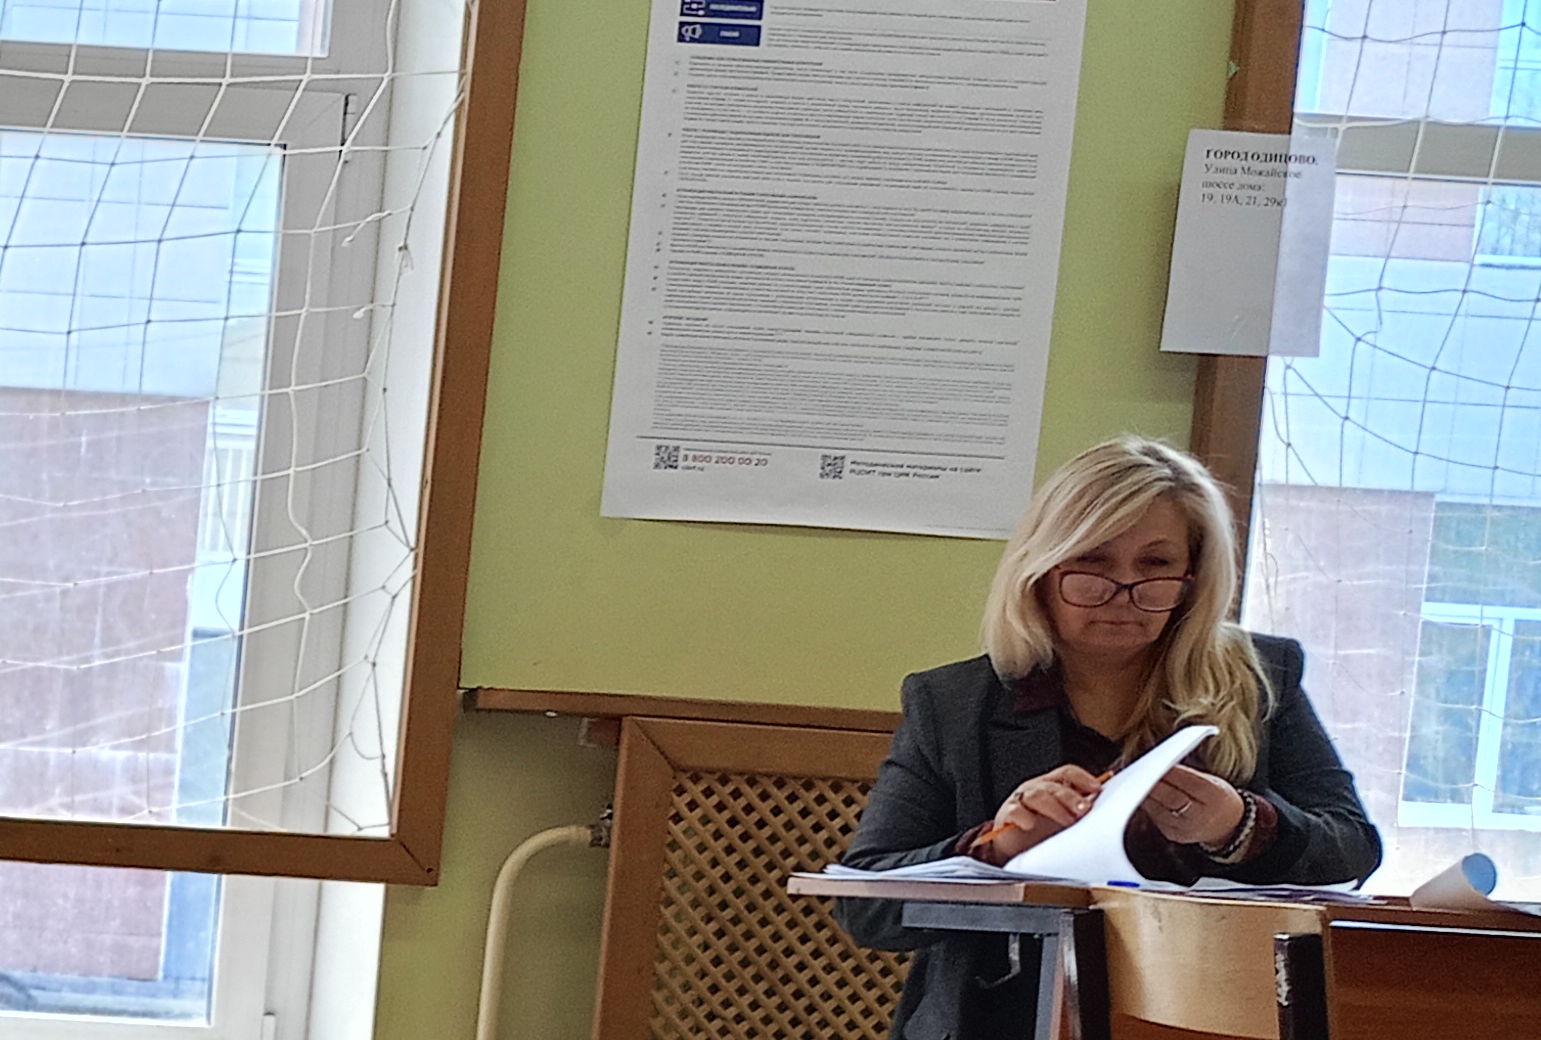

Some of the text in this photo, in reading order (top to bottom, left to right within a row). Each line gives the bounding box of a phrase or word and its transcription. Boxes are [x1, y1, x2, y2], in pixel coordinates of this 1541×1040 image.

[1205, 148, 1248, 162] ГОРОД
[1204, 163, 1302, 179] Улица Можайское
[1201, 180, 1235, 189] шоссе
[691, 454, 712, 463] 800
[714, 455, 735, 465] 200
[738, 457, 752, 466] 00
[754, 458, 768, 467] 20
